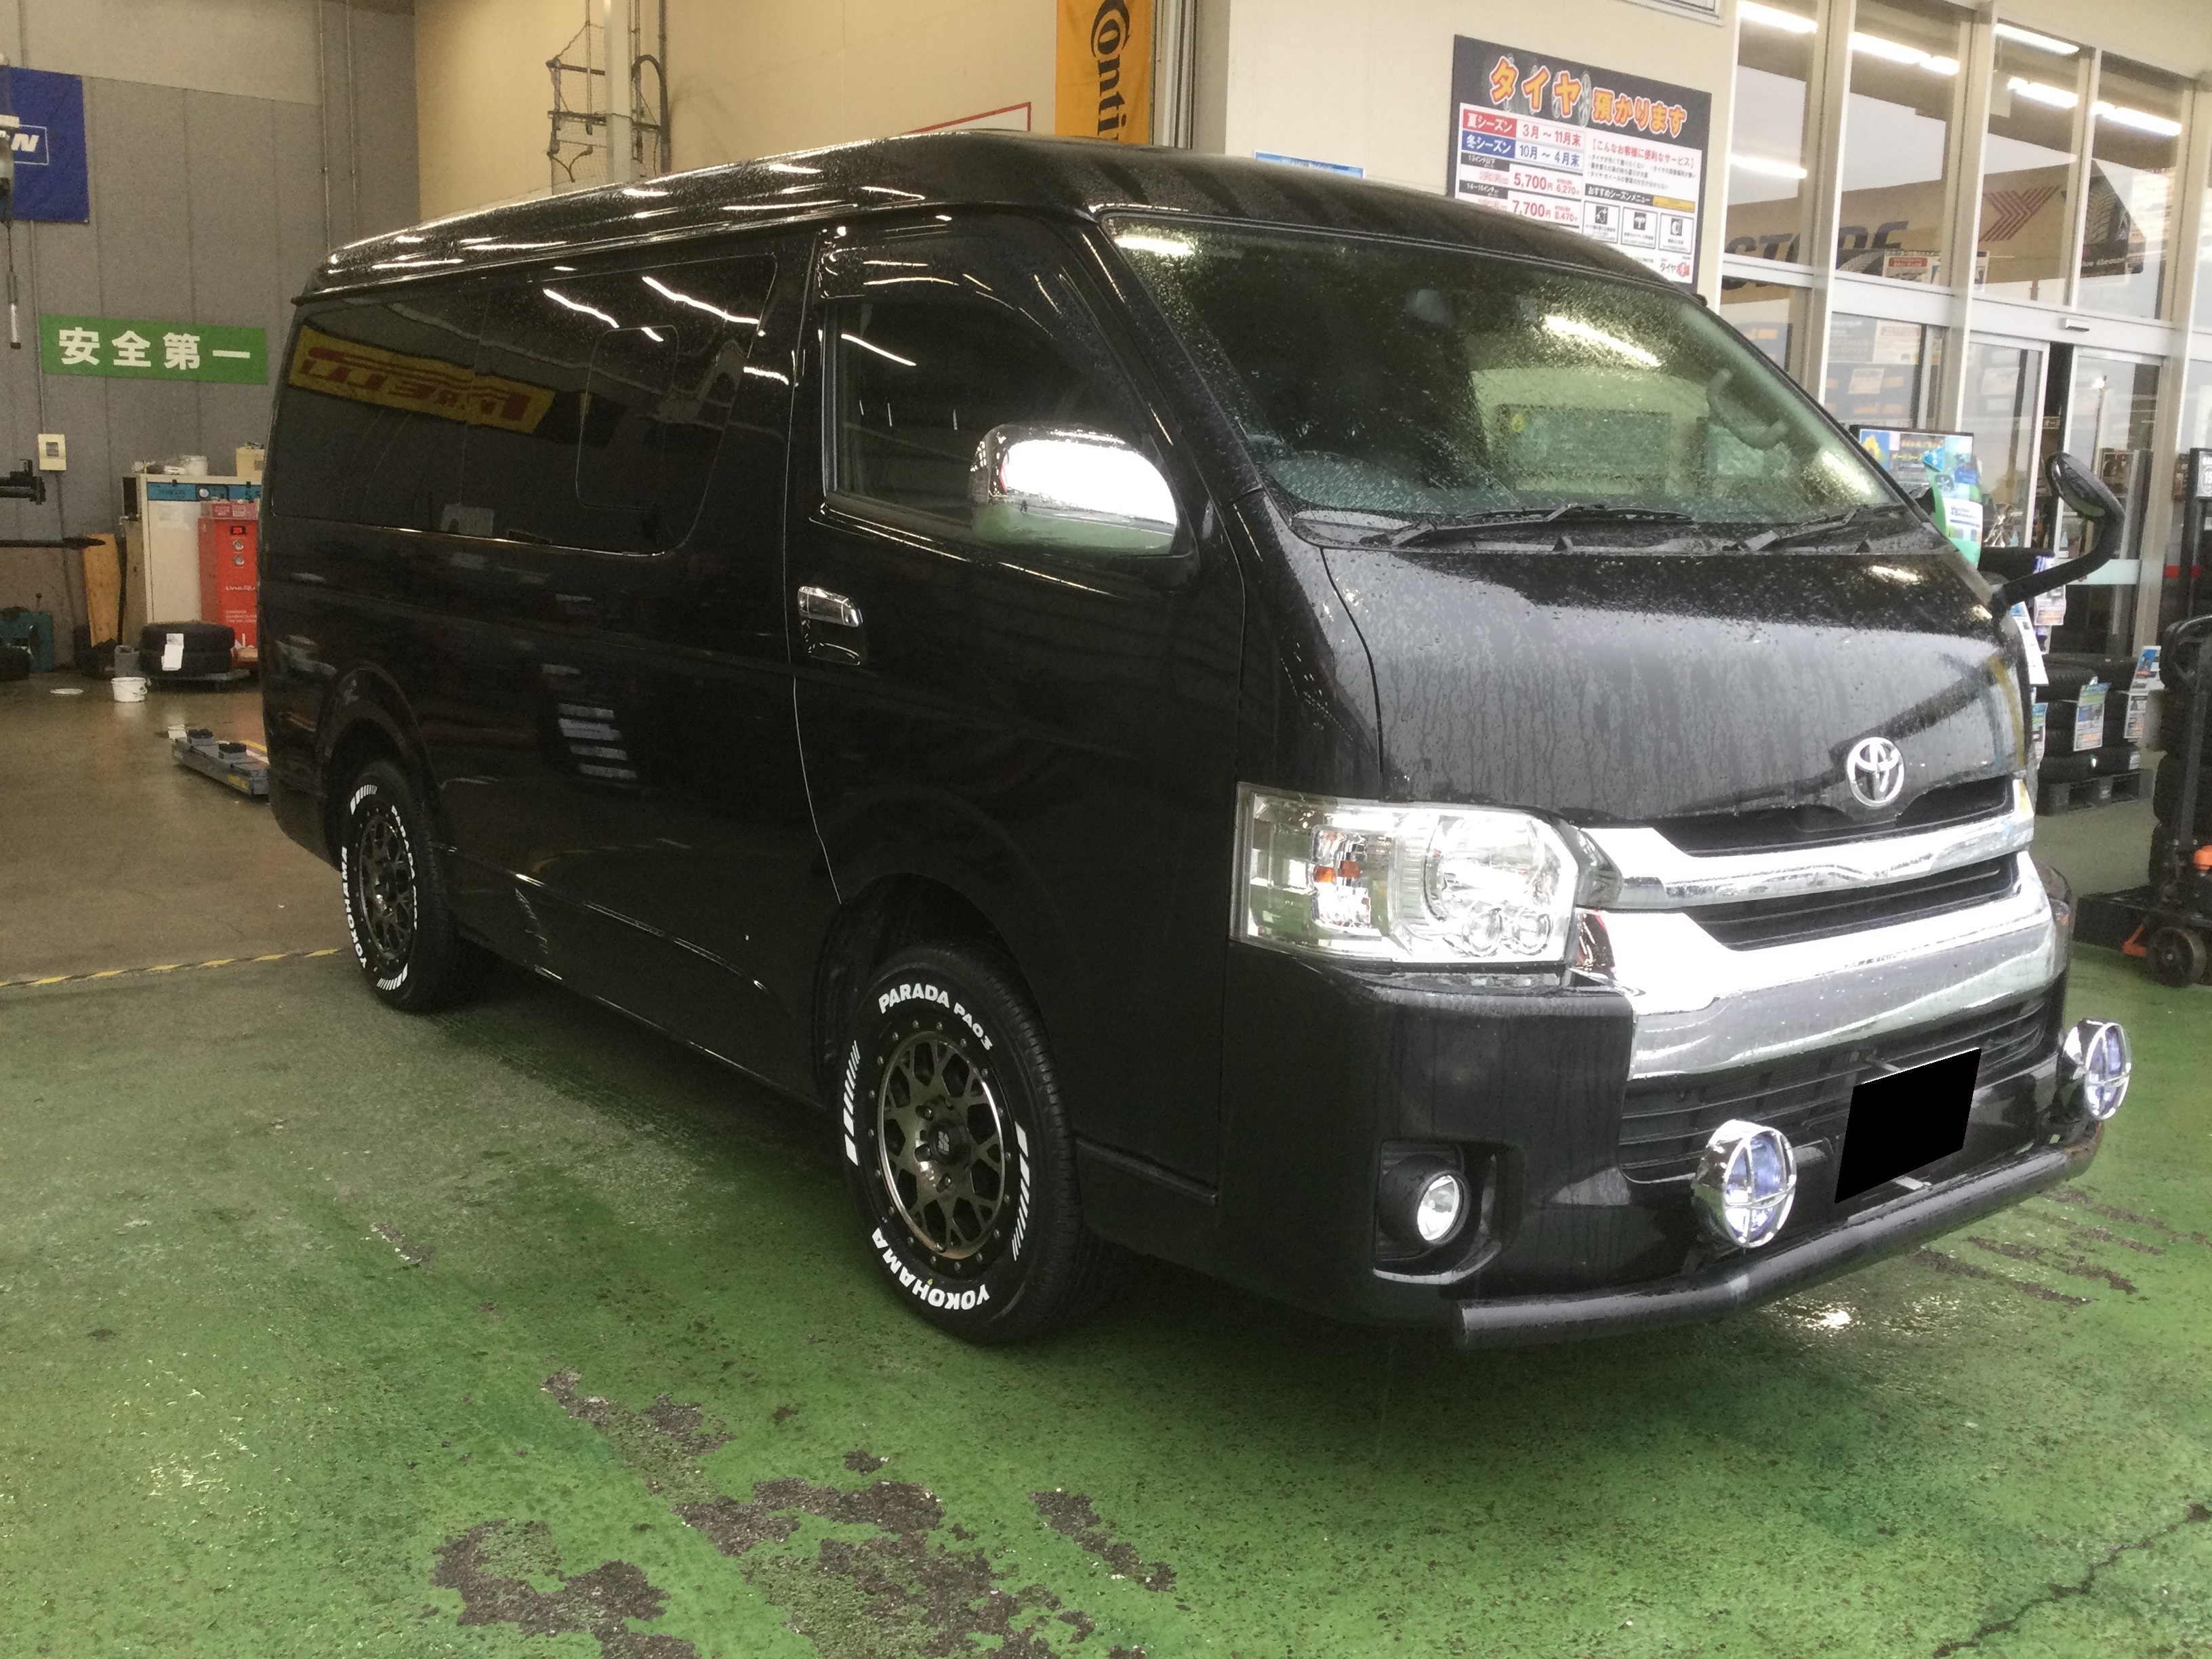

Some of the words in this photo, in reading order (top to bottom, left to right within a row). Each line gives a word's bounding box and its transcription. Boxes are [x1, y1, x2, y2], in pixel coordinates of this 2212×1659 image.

[1090, 0, 1130, 140] Conti
[1490, 56, 1582, 117] タイヤ
[1592, 86, 1687, 138] 預かります
[1467, 112, 1513, 134] 夏シーズン
[1467, 134, 1511, 154] 冬シーズン
[1514, 172, 1553, 191] 5,700円
[58, 327, 251, 371] 安全第一
[878, 983, 949, 1014] PARADA
[872, 1227, 990, 1310] YOKOHAMA
